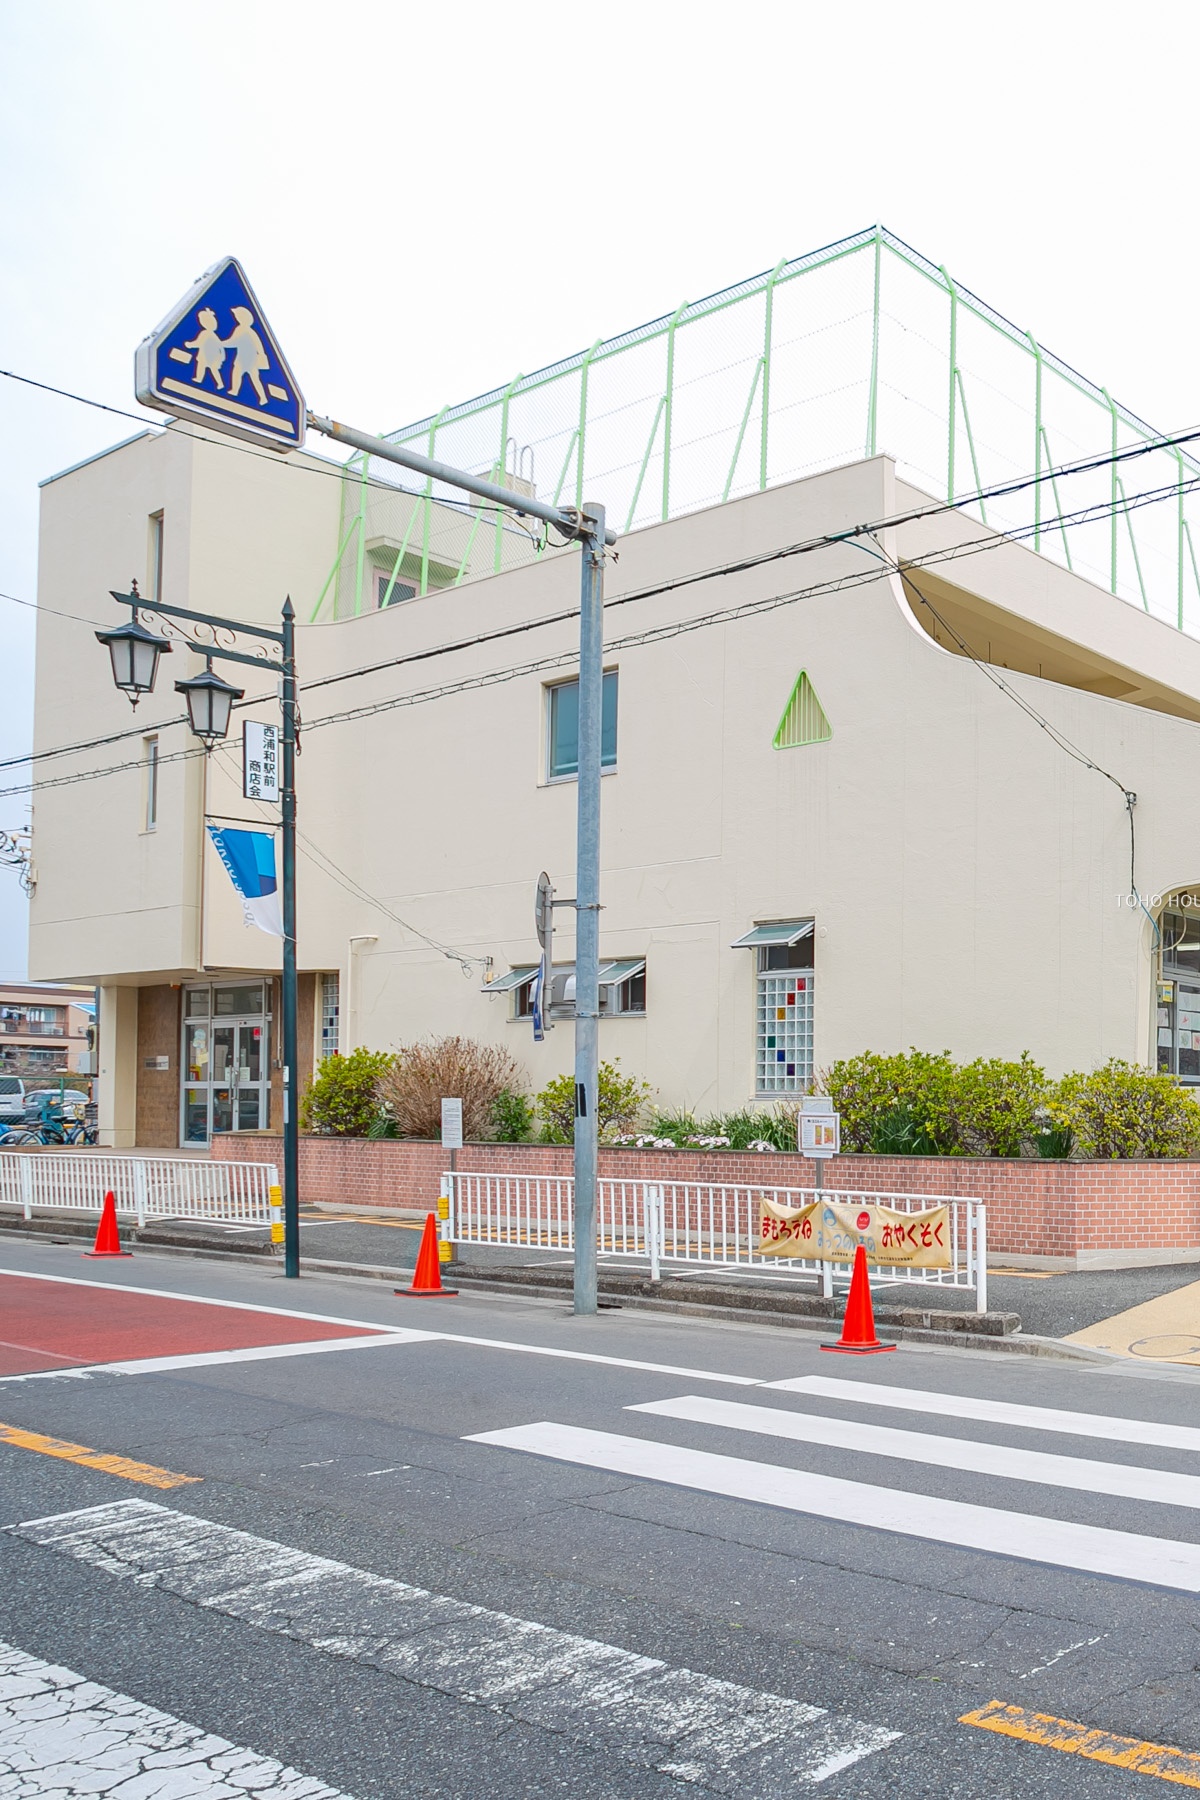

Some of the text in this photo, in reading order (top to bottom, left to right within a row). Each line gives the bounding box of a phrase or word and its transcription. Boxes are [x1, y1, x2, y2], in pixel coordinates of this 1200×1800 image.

[263, 725, 275, 787] 西浦和駅前
[249, 760, 261, 797] 商店会
[762, 1215, 812, 1241] まもろうね
[881, 1222, 944, 1248] おやくそく
